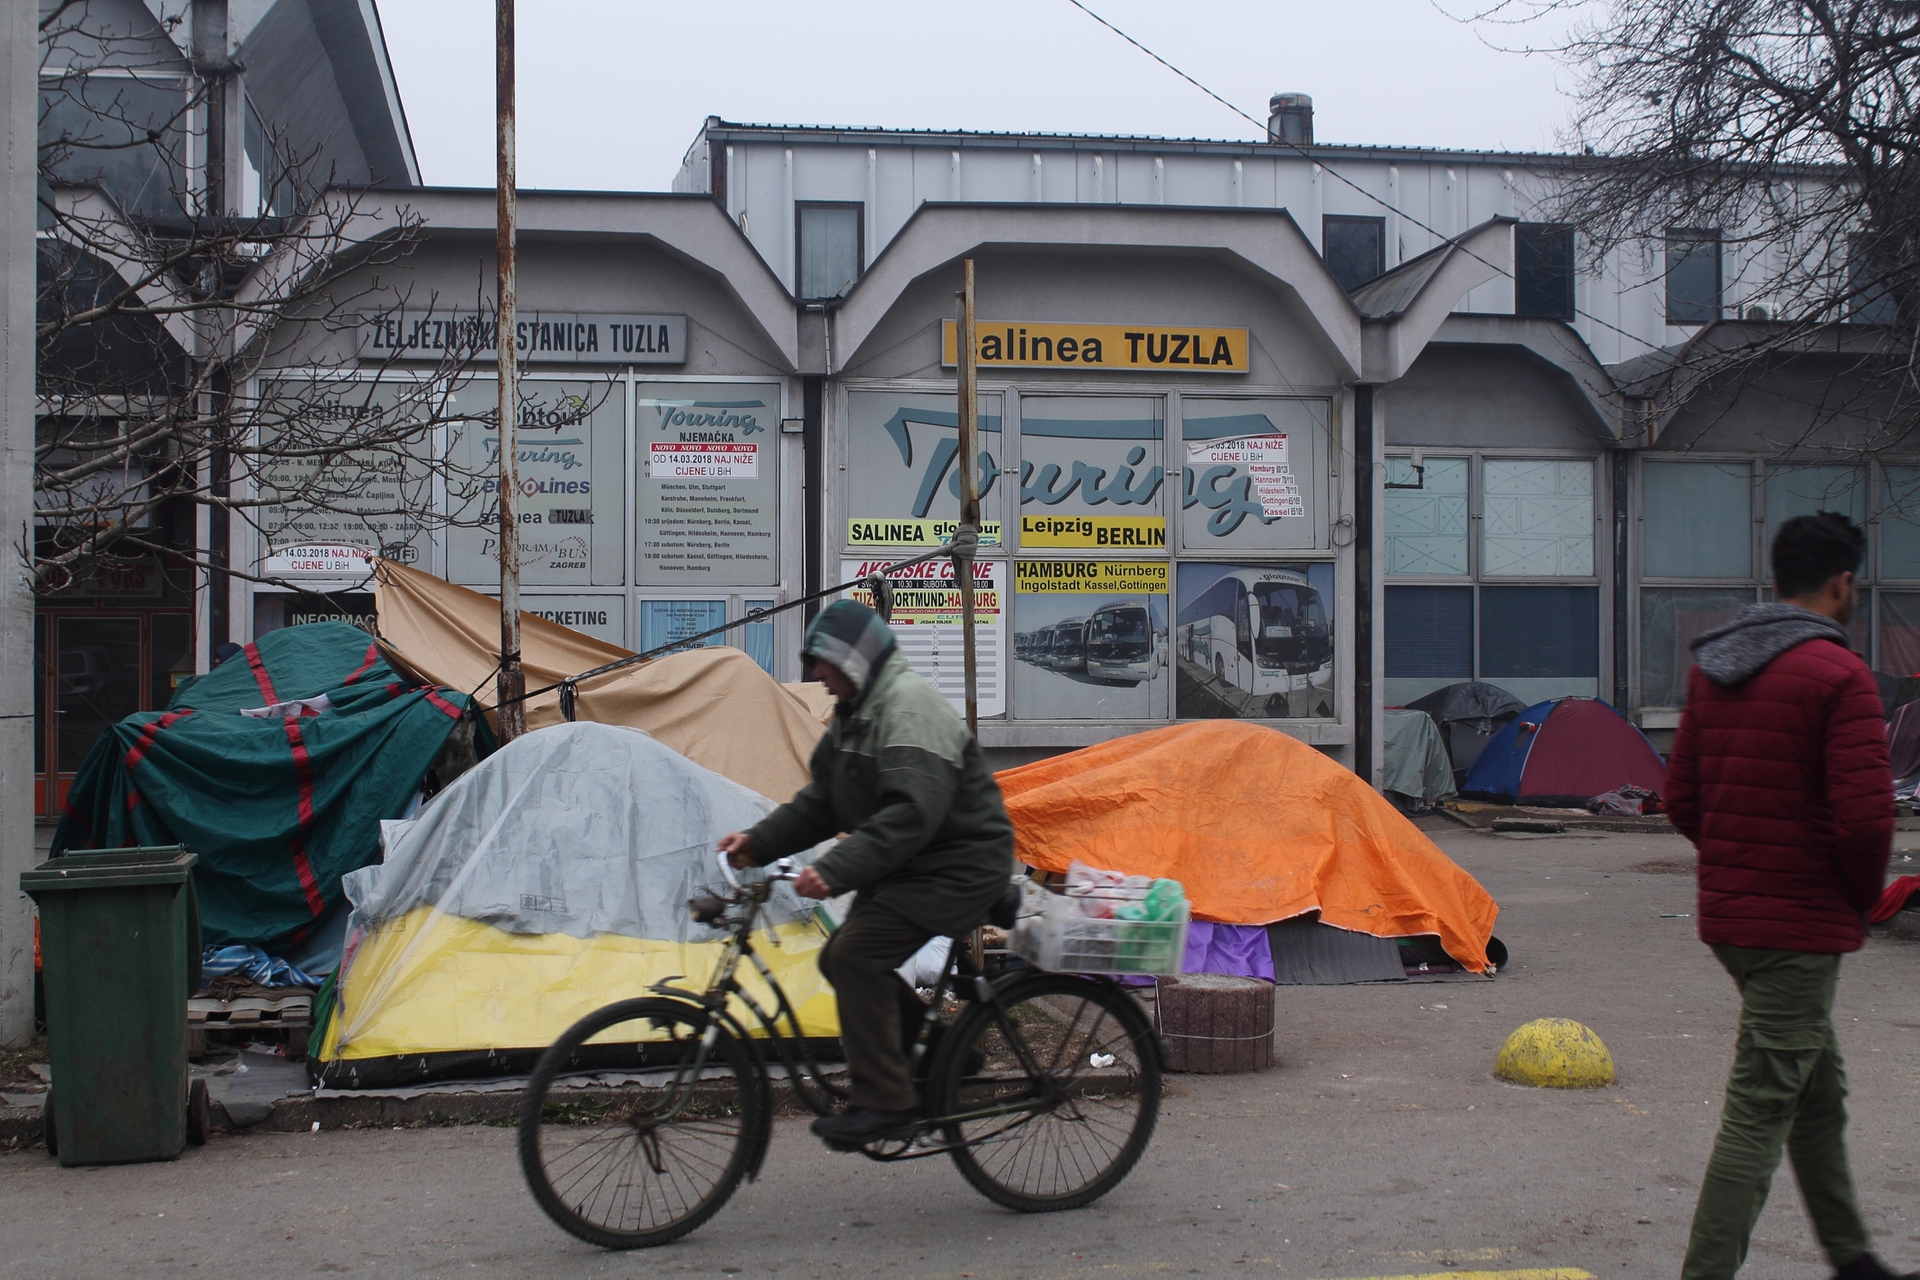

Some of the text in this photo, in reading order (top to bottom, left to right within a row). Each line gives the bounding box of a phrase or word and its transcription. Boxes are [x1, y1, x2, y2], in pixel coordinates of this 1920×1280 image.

[516, 321, 599, 352] STANICA
[610, 323, 670, 353] TUZLA
[974, 328, 1233, 366] alinea TUZLA
[653, 398, 766, 436] Touring
[680, 430, 735, 443] NJEMAČKA
[680, 444, 702, 452] NOVO
[1246, 441, 1263, 450] NAJ
[1265, 440, 1284, 450] NIŽE
[482, 437, 584, 470] Turing
[653, 455, 667, 464] OD
[669, 454, 712, 464] 14.03.2018
[714, 455, 732, 464] NAJ
[734, 453, 754, 464] NIŽE
[1210, 452, 1264, 461] CIJENE U BiH
[675, 466, 732, 476] CIJENE U BiH
[1250, 465, 1275, 473] Hamburg
[1255, 475, 1282, 484] Hannover
[366, 490, 395, 500] Čapljina
[1261, 496, 1288, 506] Gottingen
[556, 509, 586, 523] TUZLA
[1264, 507, 1290, 516] Kassel
[852, 523, 925, 542] SALINEA
[1022, 517, 1166, 545] Leipzig BERLIN
[285, 548, 330, 558] 14.03.2018
[331, 549, 349, 558] NAJ
[558, 548, 588, 559] BUS
[291, 560, 350, 570] CIJENE U BiH
[549, 561, 586, 569] ZAGREB
[1016, 562, 1166, 579] HAMBURG Nürnberg
[898, 580, 913, 589] 10.30
[923, 580, 948, 589] SUBOTA
[1021, 580, 1081, 593] Ingolstadt
[292, 613, 375, 625] INFORMAC
